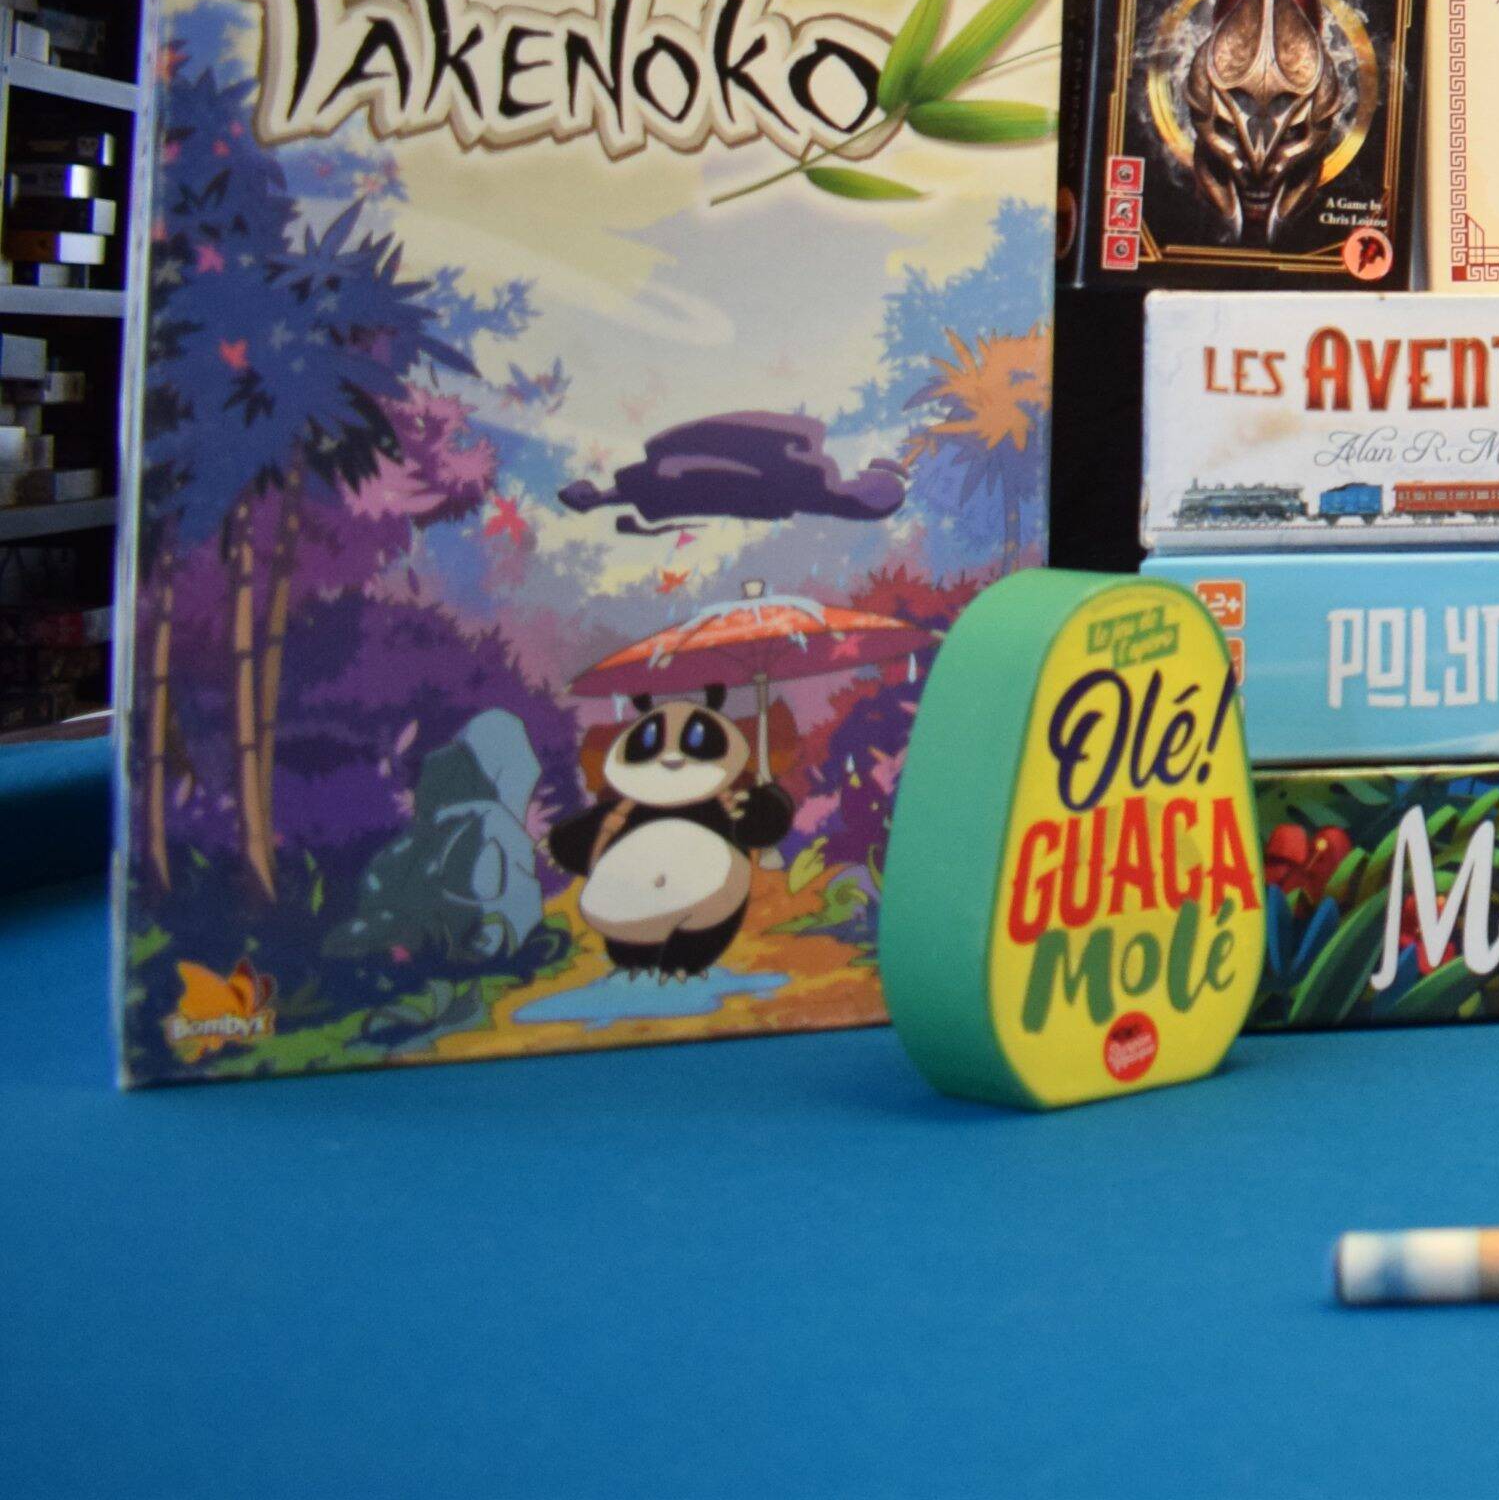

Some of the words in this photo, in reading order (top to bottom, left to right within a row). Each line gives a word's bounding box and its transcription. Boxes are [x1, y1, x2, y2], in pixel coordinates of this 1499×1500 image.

[1325, 197, 1335, 209] A
[1336, 197, 1368, 211] Game
[1203, 344, 1286, 398] LES
[1312, 425, 1400, 466] Alan
[1047, 660, 1238, 814] Olé!
[1007, 795, 1262, 947] GUACA
